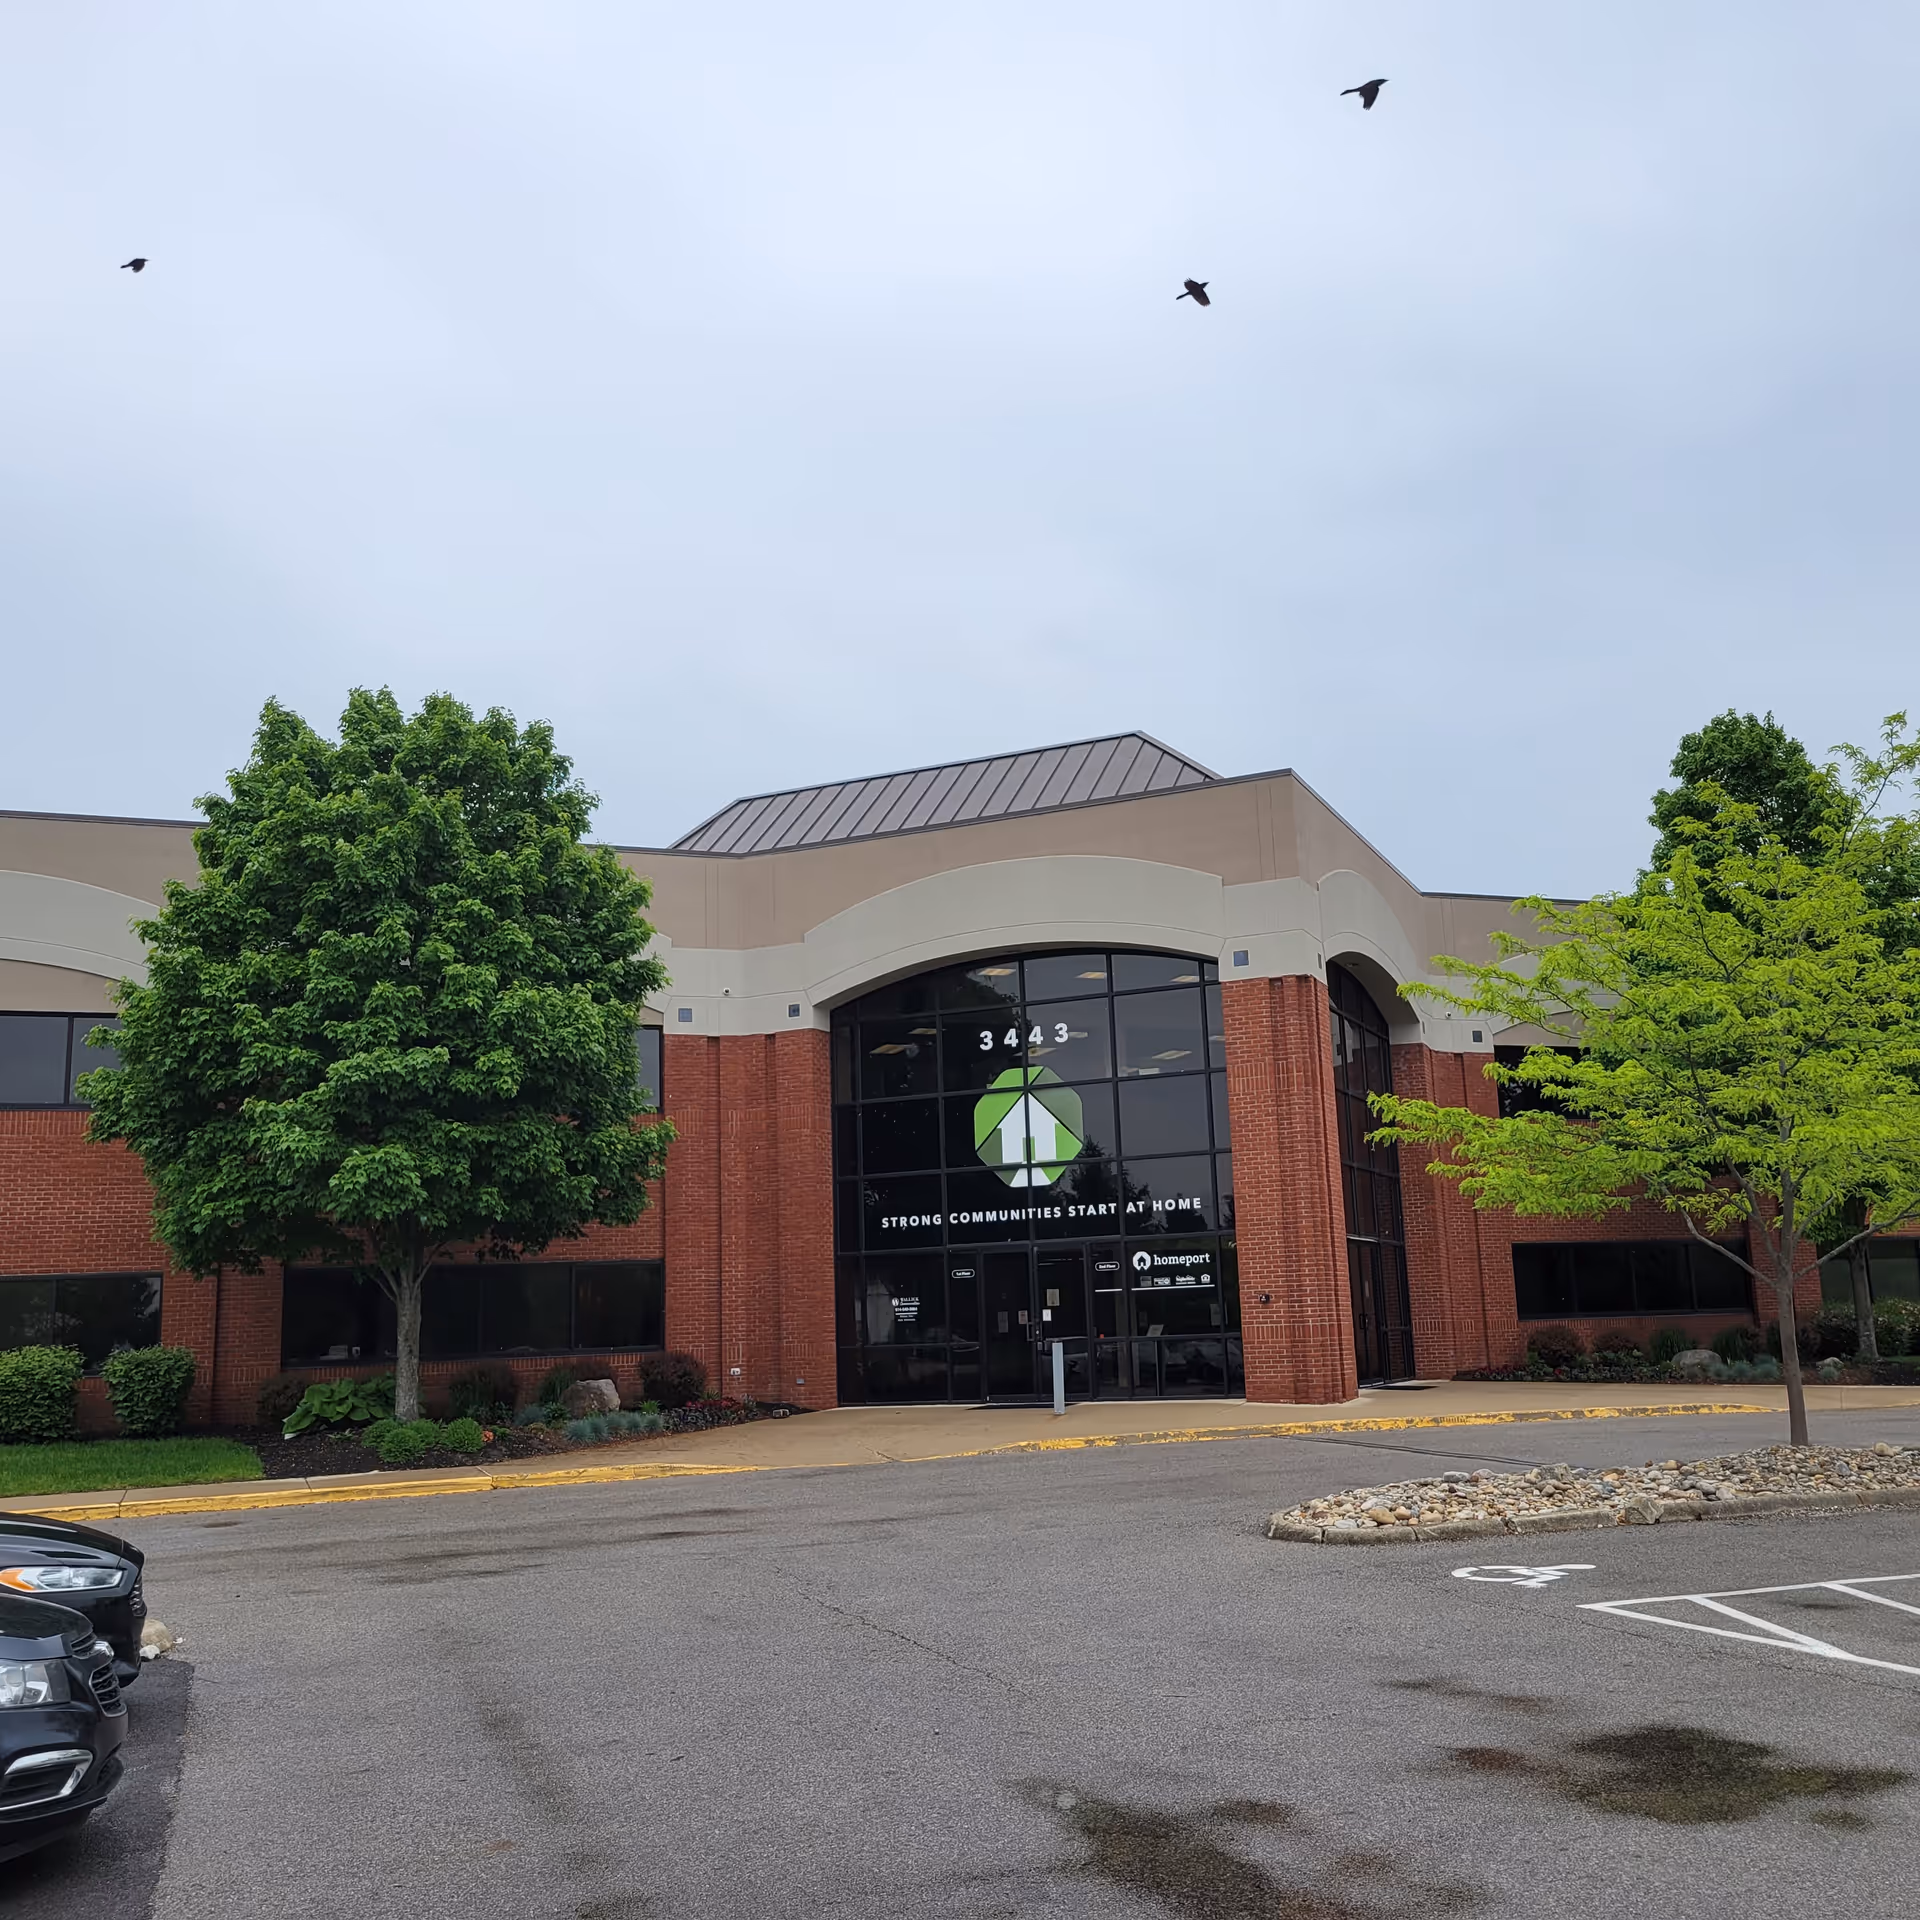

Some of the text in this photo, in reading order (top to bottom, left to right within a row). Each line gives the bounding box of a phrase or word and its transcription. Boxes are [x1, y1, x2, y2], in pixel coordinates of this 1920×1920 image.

[979, 1022, 1069, 1051] 3443
[881, 1197, 1202, 1229] STRONG COMMUNITIES START AT HOME
[1153, 1252, 1211, 1267] homeport
